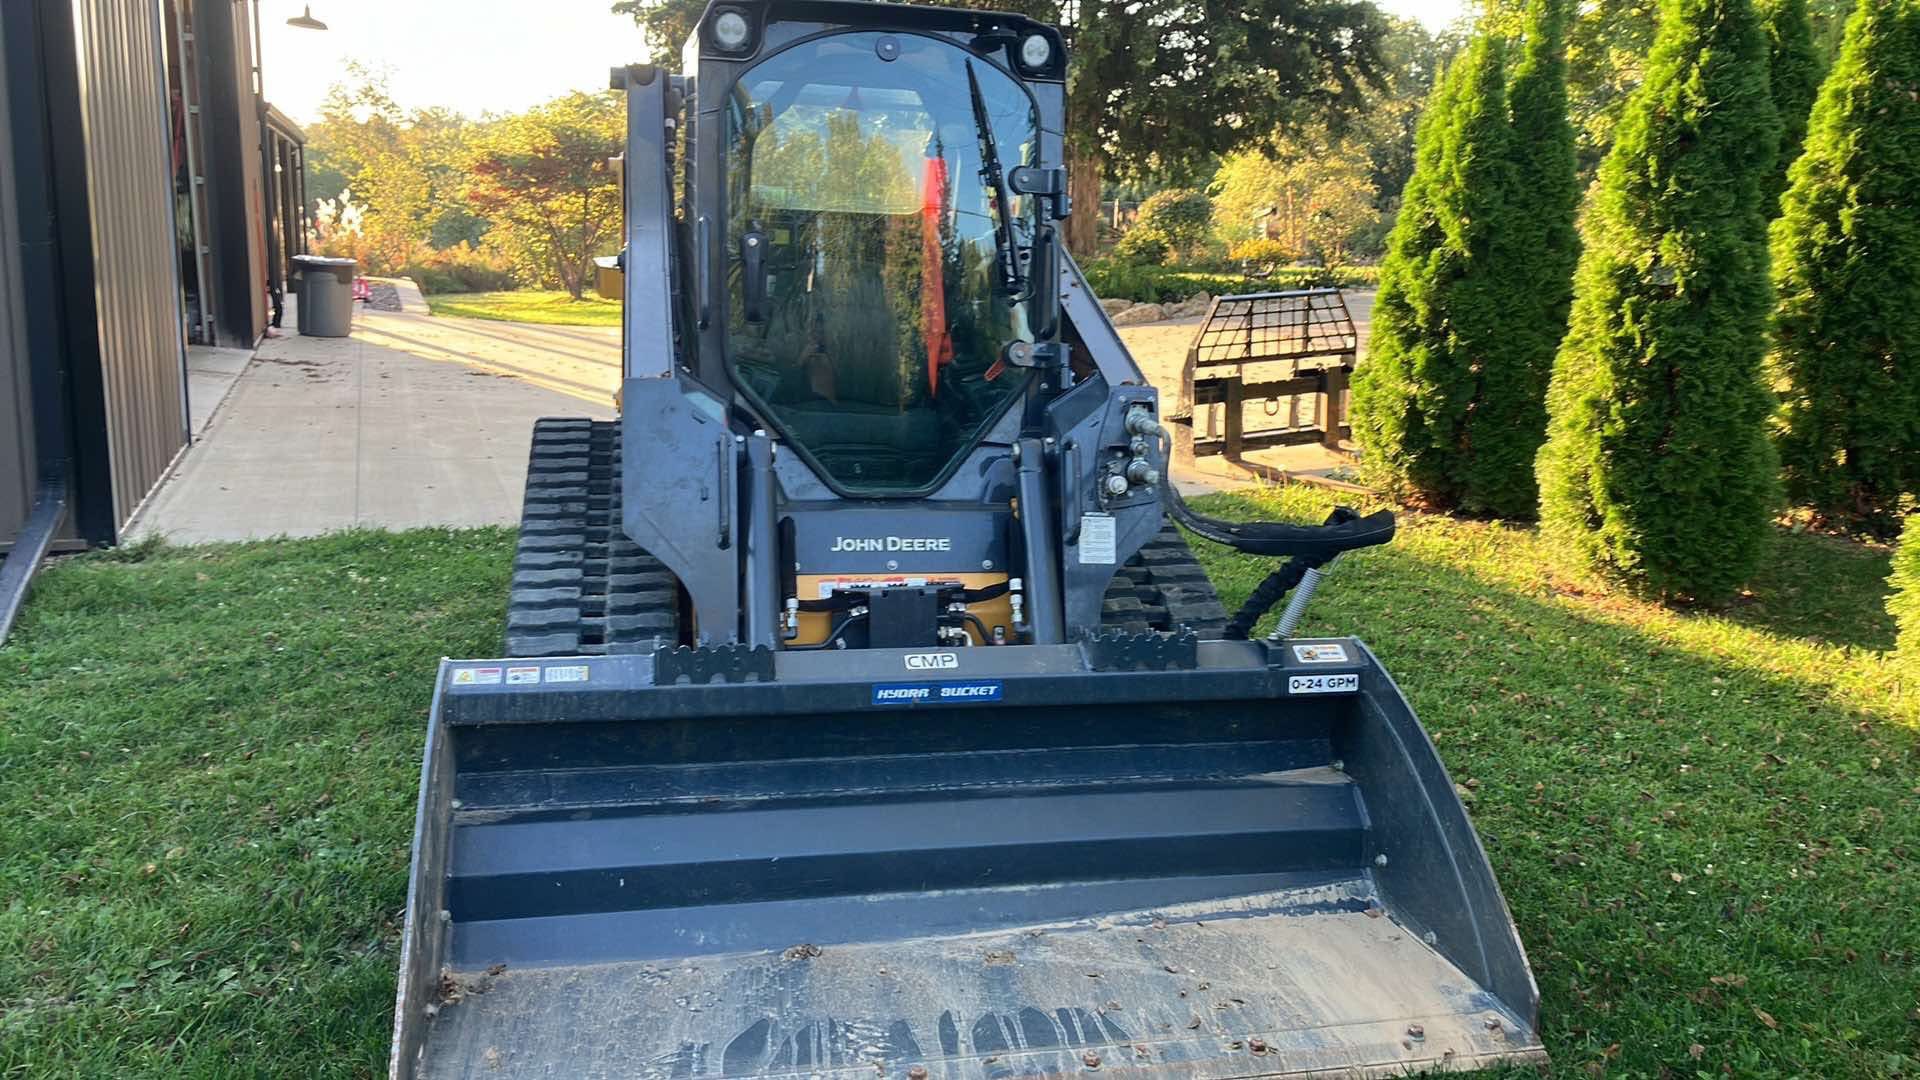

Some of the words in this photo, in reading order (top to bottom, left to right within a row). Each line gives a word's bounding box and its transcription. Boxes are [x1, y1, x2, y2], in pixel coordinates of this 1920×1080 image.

[831, 536, 883, 552] JOHN
[886, 536, 951, 551] DEERE
[907, 654, 955, 668] CMP
[1292, 678, 1323, 690] 0-24
[1327, 677, 1356, 688] GPM
[877, 688, 930, 700] HYDRA
[940, 685, 998, 697] BUCKET
